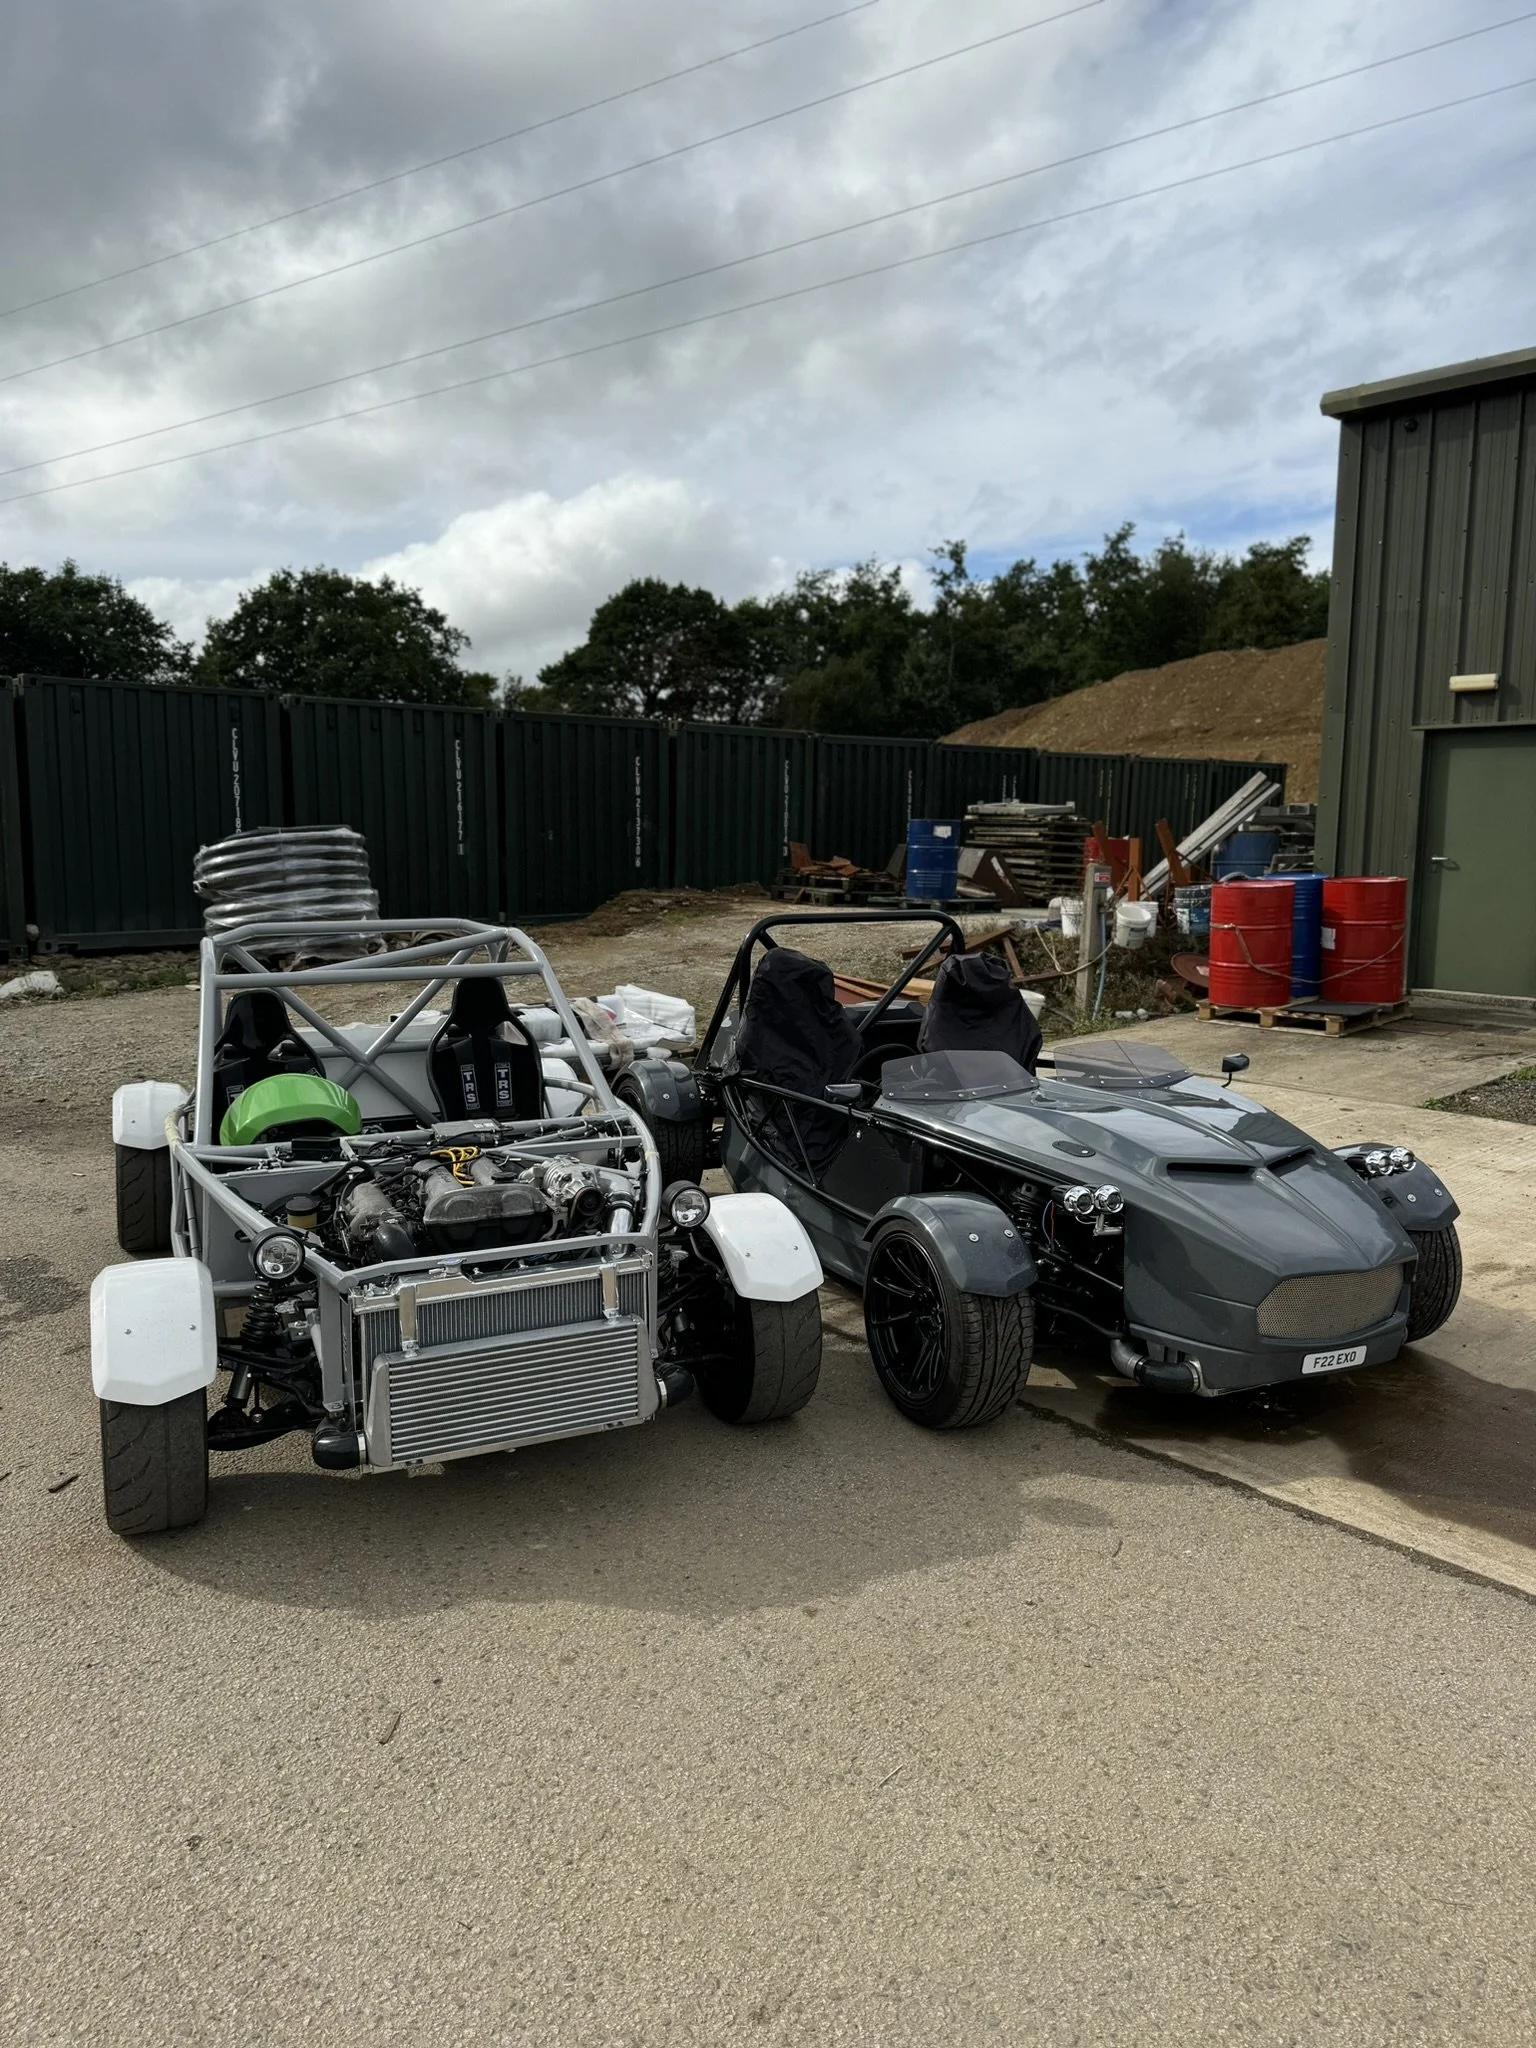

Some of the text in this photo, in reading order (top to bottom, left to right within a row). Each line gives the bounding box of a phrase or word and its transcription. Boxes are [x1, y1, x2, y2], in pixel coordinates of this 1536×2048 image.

[463, 1071, 477, 1103] TRS
[497, 1069, 510, 1100] TRS
[1313, 1351, 1357, 1369] F22 EXO
